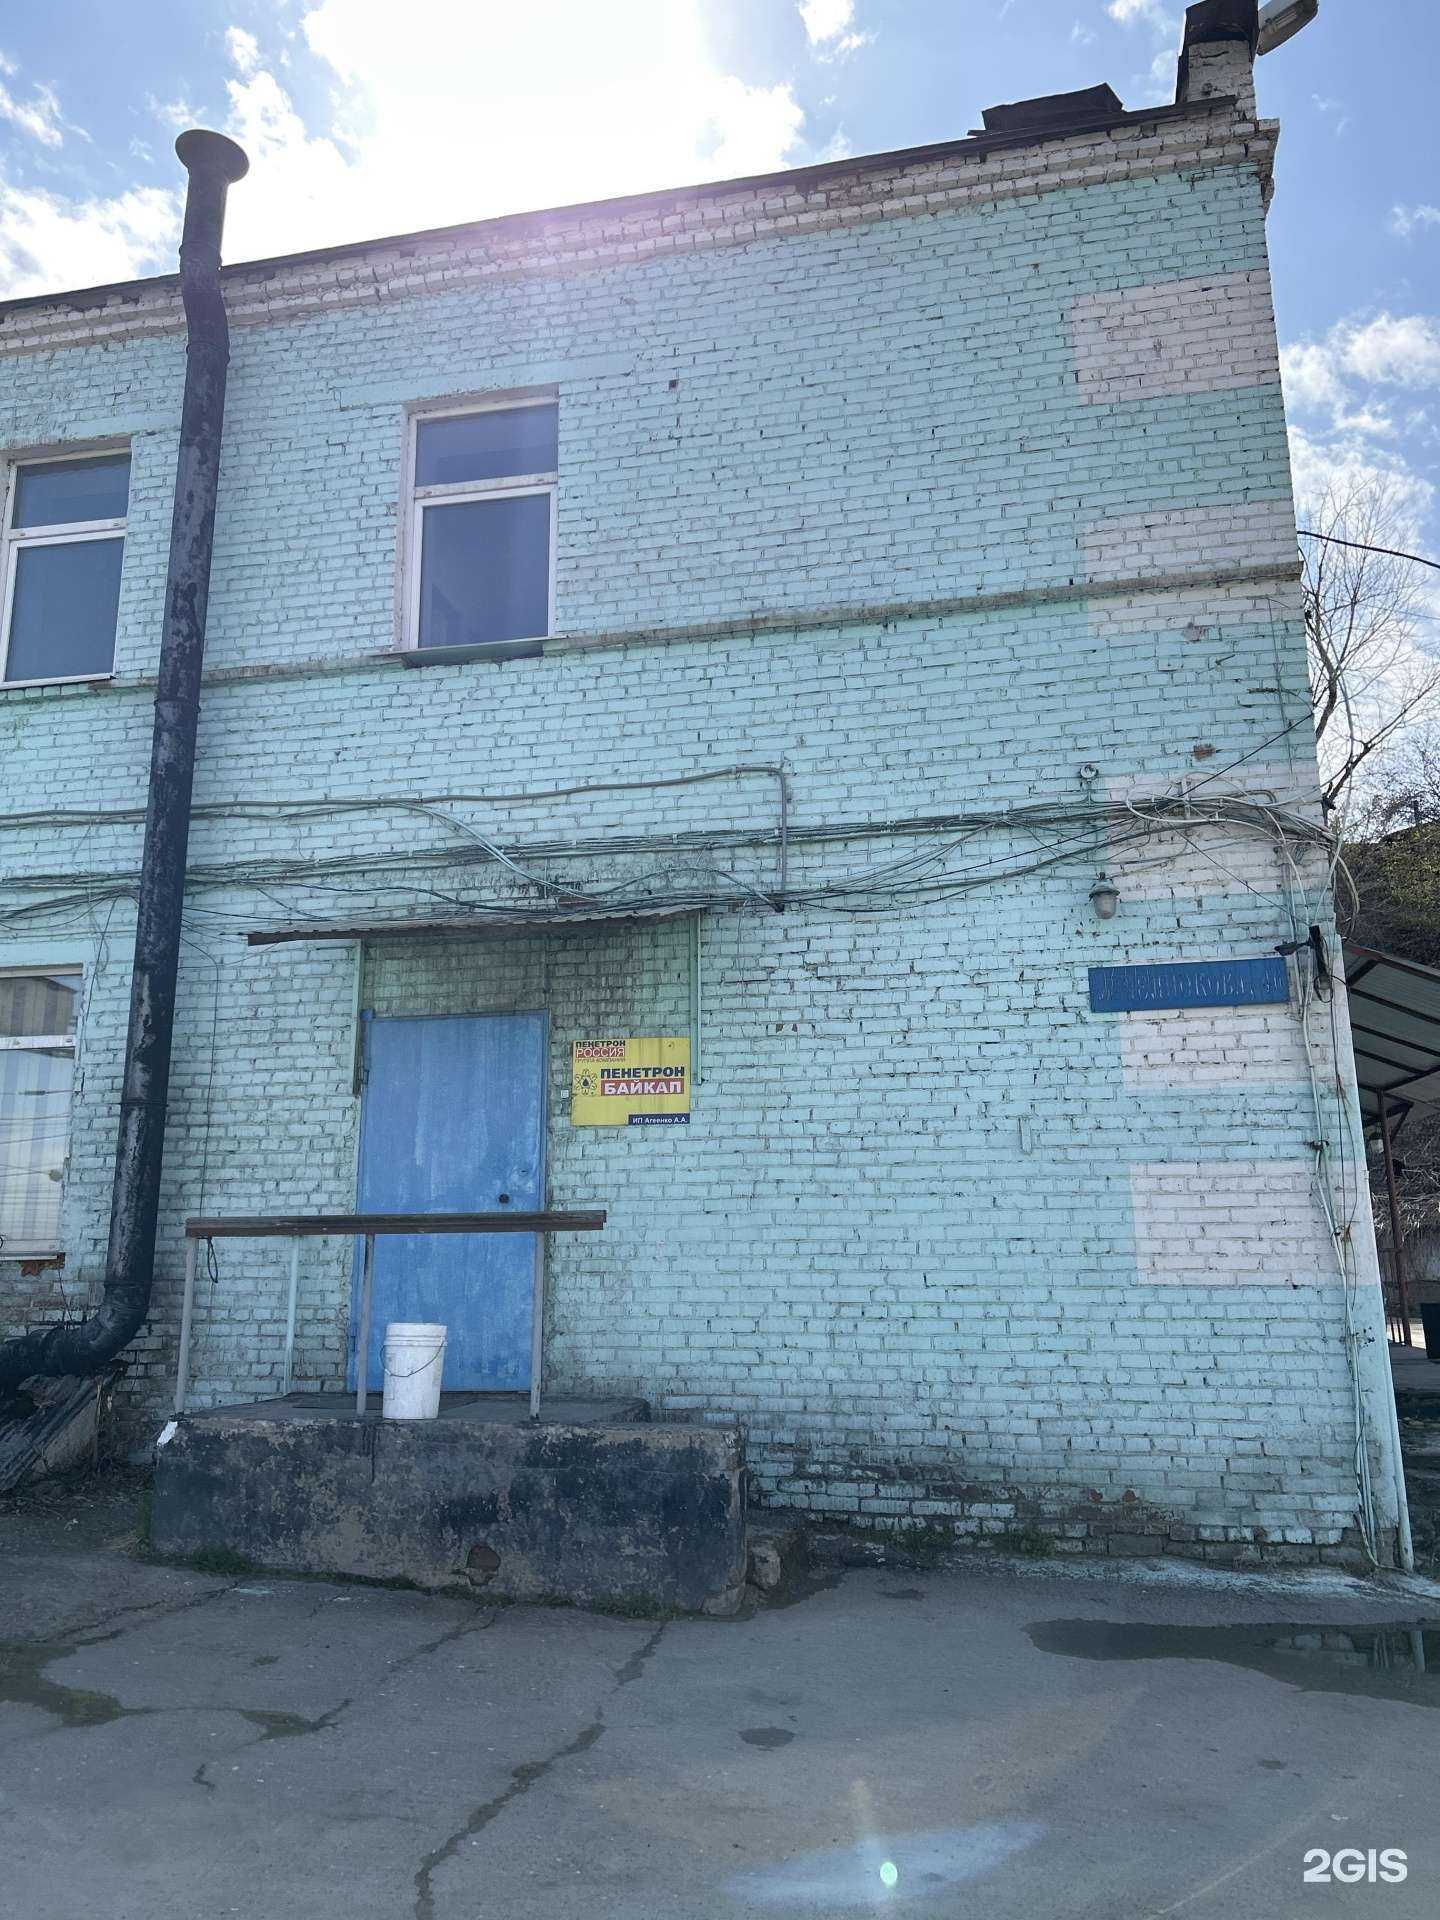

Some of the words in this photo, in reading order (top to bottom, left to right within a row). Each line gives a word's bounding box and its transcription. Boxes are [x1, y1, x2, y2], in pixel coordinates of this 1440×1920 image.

[576, 1047, 625, 1058] РОССИЯ
[600, 1066, 685, 1079] ПЕНЕТРОН
[604, 1079, 681, 1095] БАЙКАЛ
